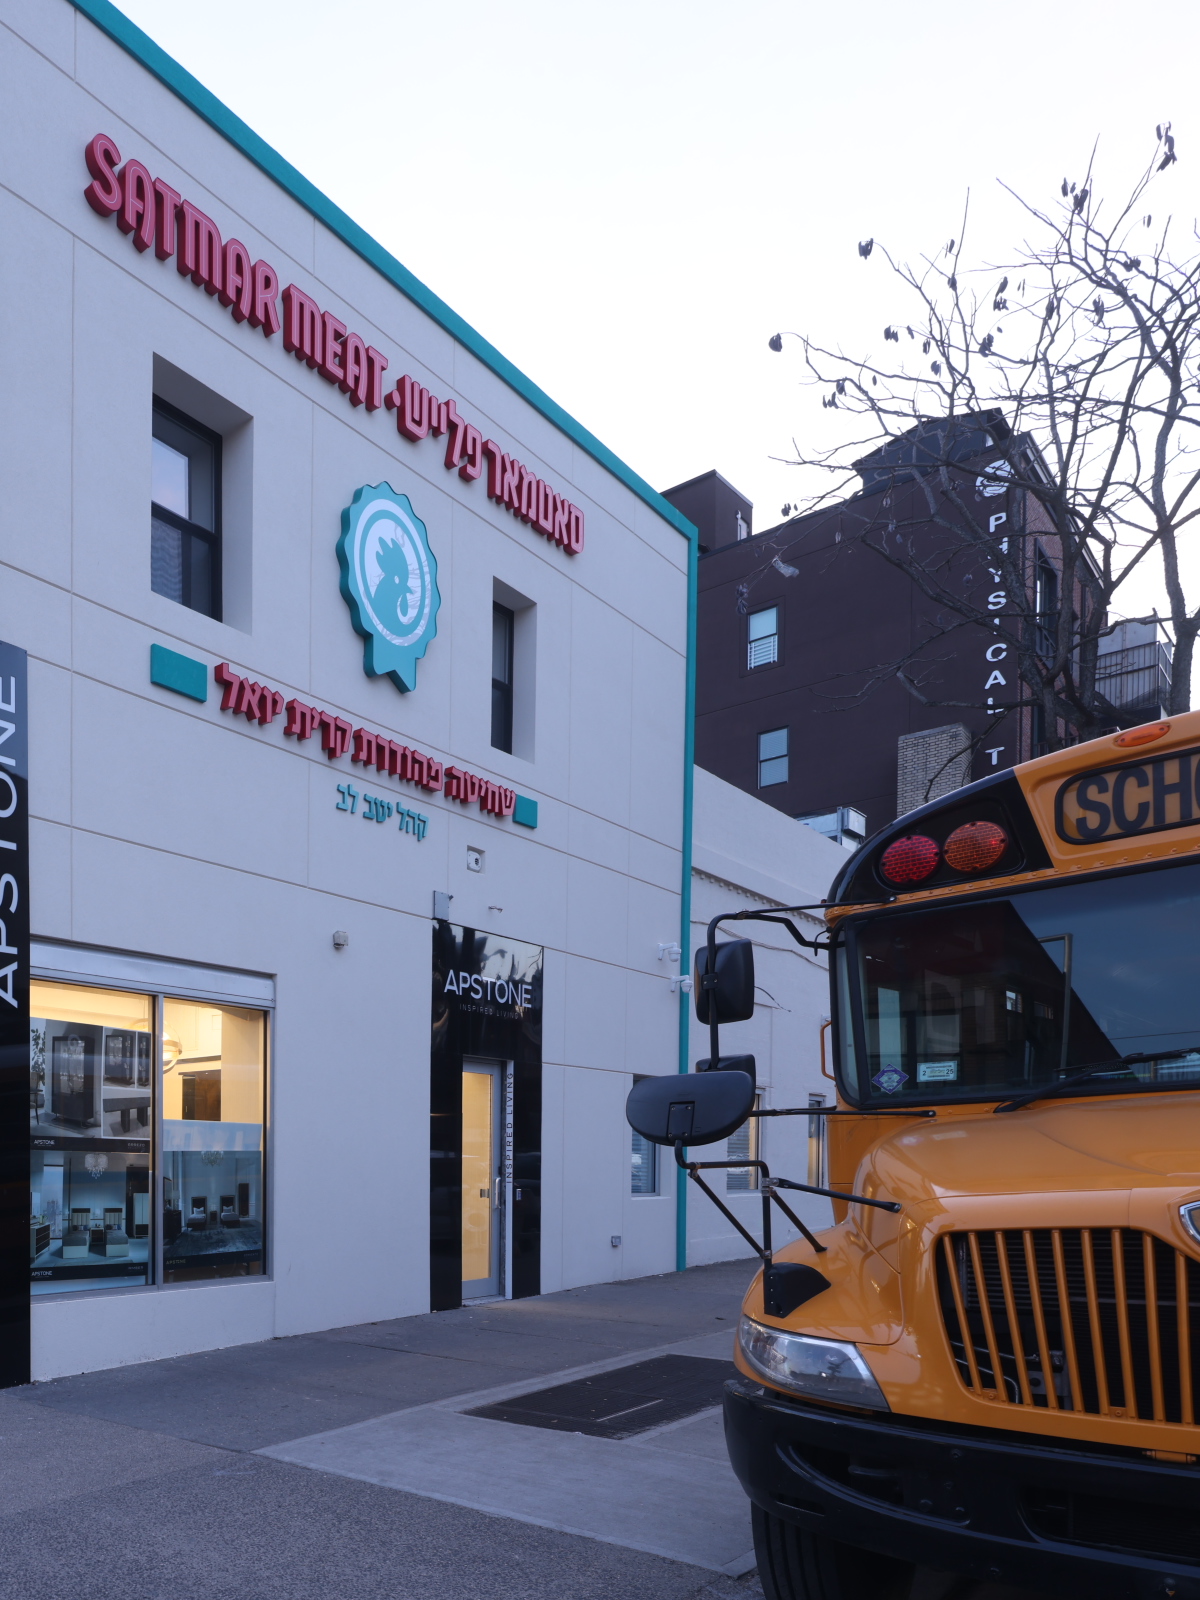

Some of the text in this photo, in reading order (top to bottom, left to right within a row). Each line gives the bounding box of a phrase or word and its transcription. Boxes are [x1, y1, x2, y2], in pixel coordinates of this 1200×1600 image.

[84, 133, 388, 412] SATMAR MEAT
[396, 374, 585, 556] סאטמאר פלייש
[214, 662, 284, 726] יואל
[336, 784, 360, 814] לב
[396, 801, 429, 842] קהל
[1076, 754, 1200, 840] SCH
[444, 968, 532, 1008] APSTONE
[460, 1004, 493, 1016] INSPIRED
